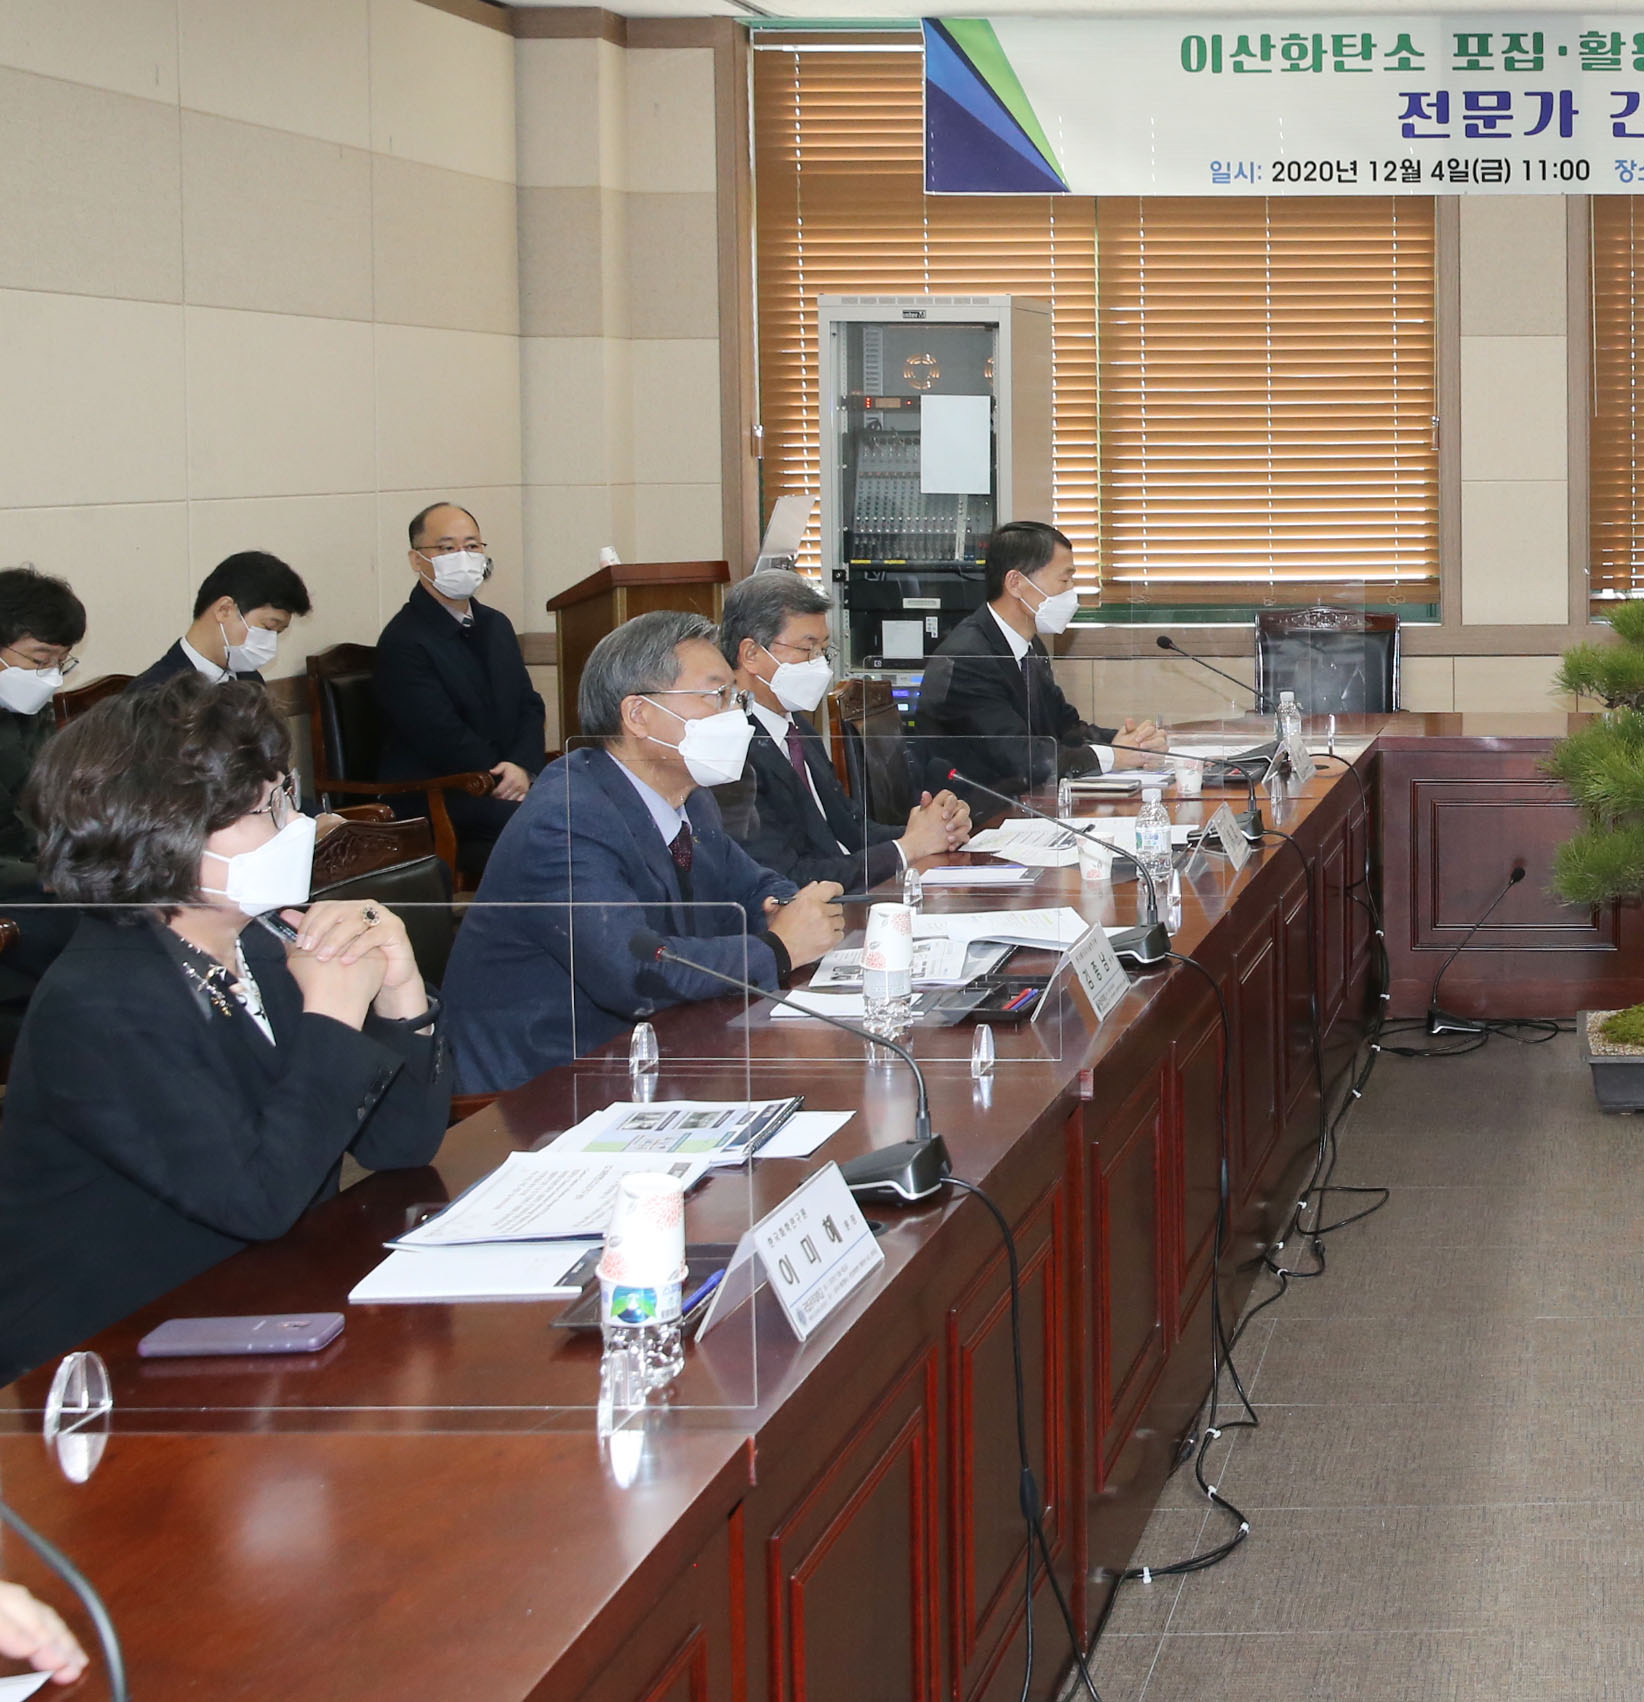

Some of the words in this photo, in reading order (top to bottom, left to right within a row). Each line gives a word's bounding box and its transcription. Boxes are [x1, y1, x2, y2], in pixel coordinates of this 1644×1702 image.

[1180, 32, 1426, 73] 이산화탄소
[1398, 90, 1579, 139] 전문가
[1209, 160, 1263, 184] 일시:
[1271, 161, 1358, 184] 2020년
[1369, 160, 1422, 184] 12월
[1430, 158, 1512, 185] 4일(금)
[1522, 159, 1591, 182] 11:00
